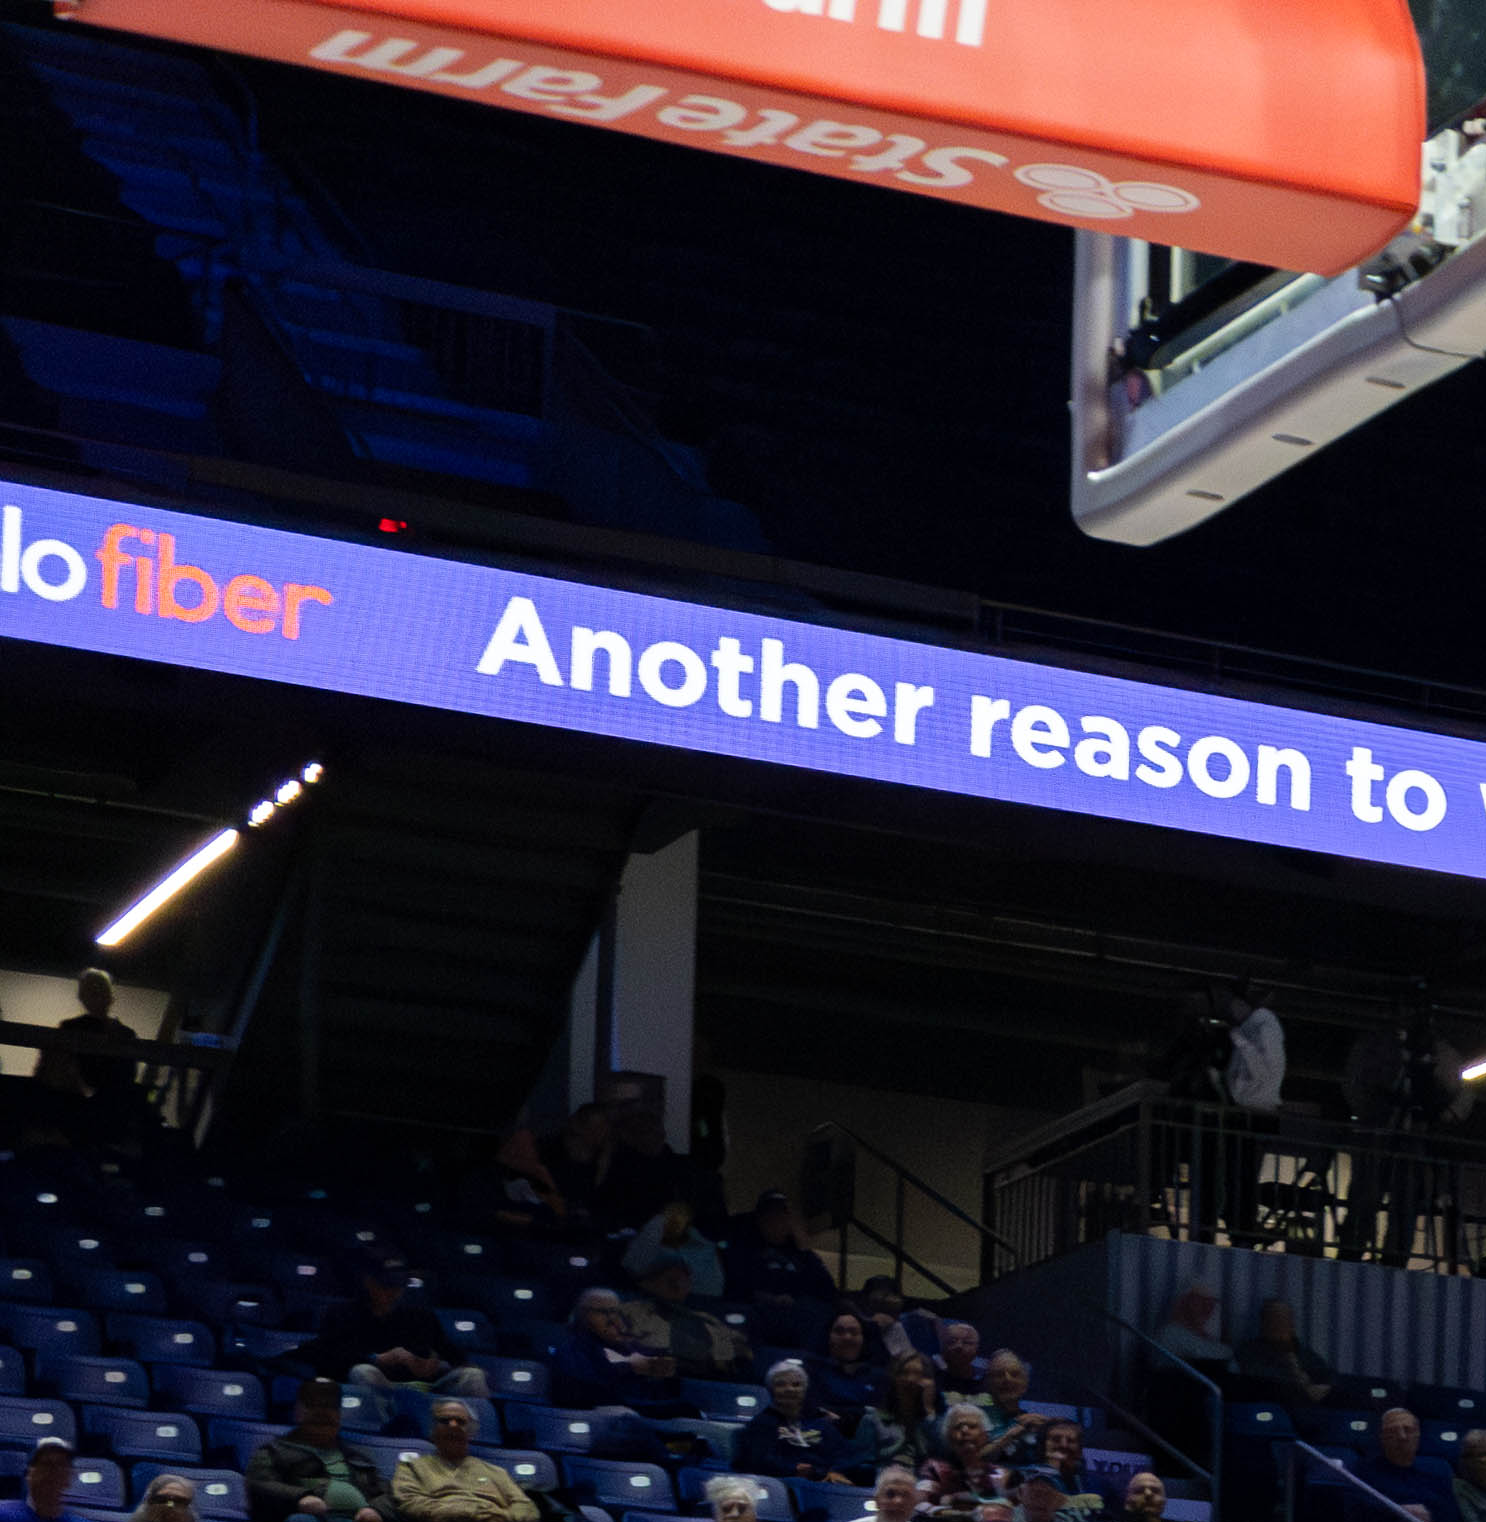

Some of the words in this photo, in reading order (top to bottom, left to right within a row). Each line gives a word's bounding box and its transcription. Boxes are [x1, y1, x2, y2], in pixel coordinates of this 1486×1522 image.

[0, 504, 87, 602] lo
[477, 596, 934, 744] Another
[970, 693, 1313, 810] reason
[1345, 745, 1446, 832] to
